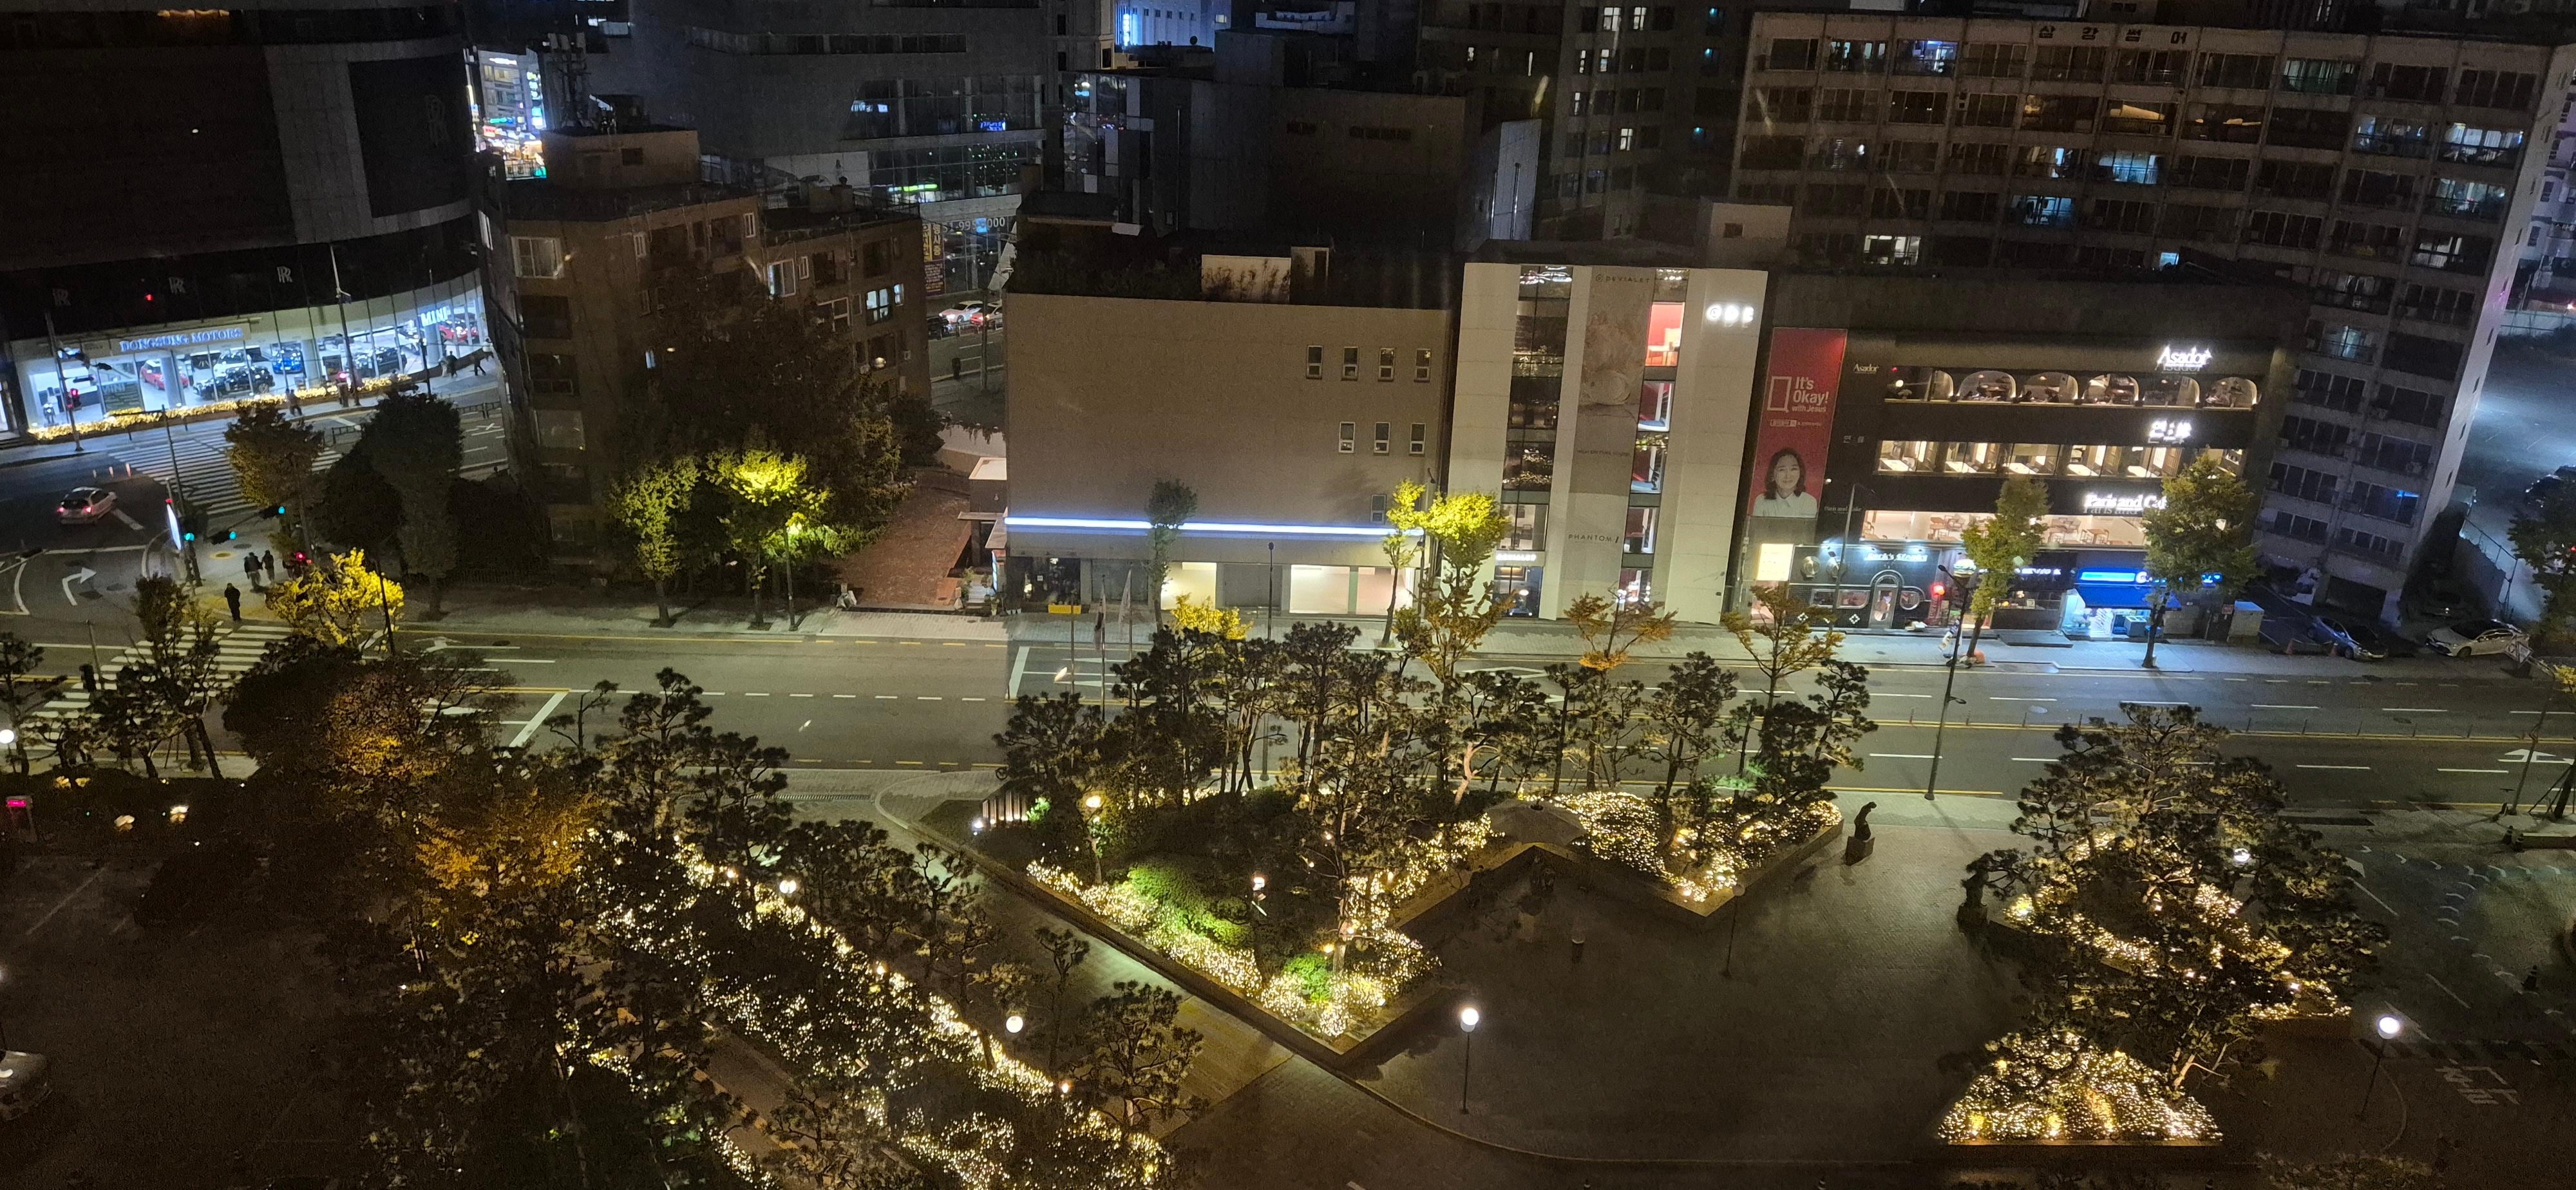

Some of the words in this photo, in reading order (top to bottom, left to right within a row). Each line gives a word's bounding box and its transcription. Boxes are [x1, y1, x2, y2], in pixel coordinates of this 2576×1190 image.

[421, 306, 448, 327] MINI
[119, 333, 189, 352] DONGSUNG
[191, 328, 243, 343] MOTORS
[2154, 345, 2213, 369] Asador
[1853, 363, 1879, 372] Asador
[1795, 376, 1815, 390] It's
[1792, 390, 1830, 406] Okay!
[2084, 493, 2117, 508] Paris
[2117, 494, 2144, 509] and
[2144, 495, 2168, 509] Ca
[1568, 534, 1612, 542] PHANTOM
[2434, 1058, 2520, 1104] 출구
